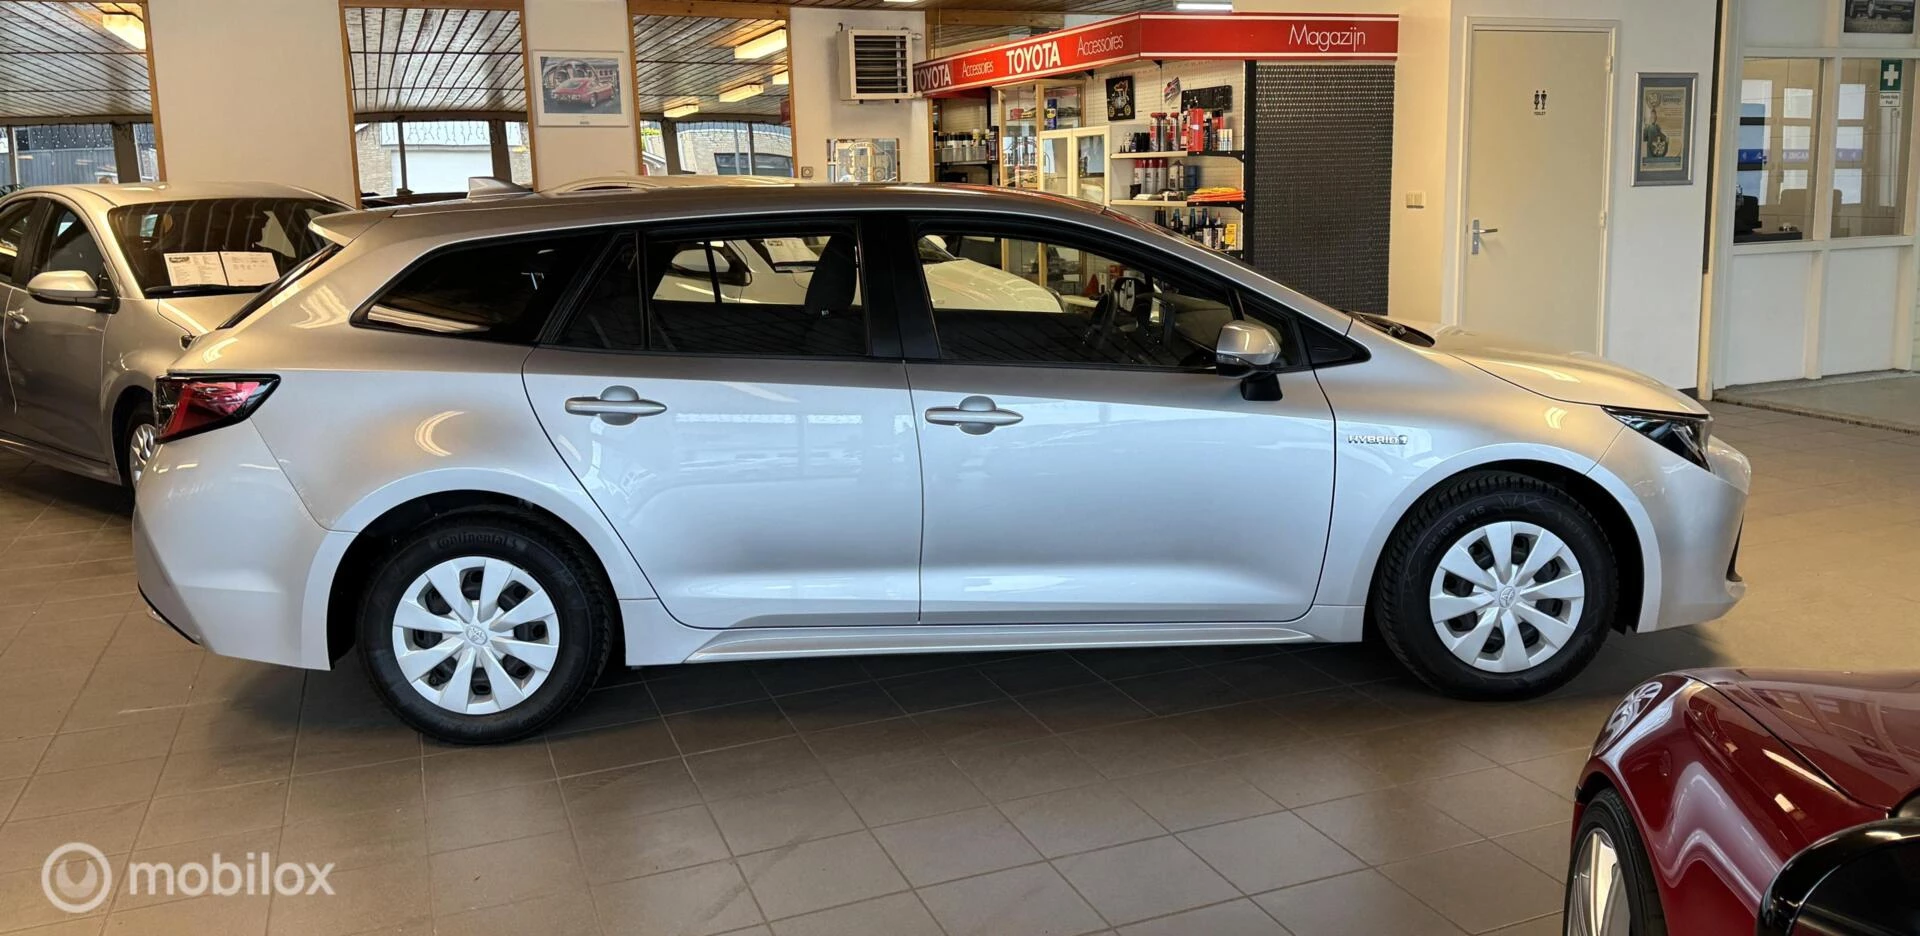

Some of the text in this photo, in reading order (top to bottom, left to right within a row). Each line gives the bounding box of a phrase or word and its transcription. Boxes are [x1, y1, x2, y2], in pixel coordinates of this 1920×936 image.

[1289, 24, 1366, 52] Magazijn
[914, 32, 1124, 91] TOYOTA Accessoires TOYOTA Accessoires
[1348, 435, 1399, 445] HYBRID
[436, 531, 508, 549] Continental
